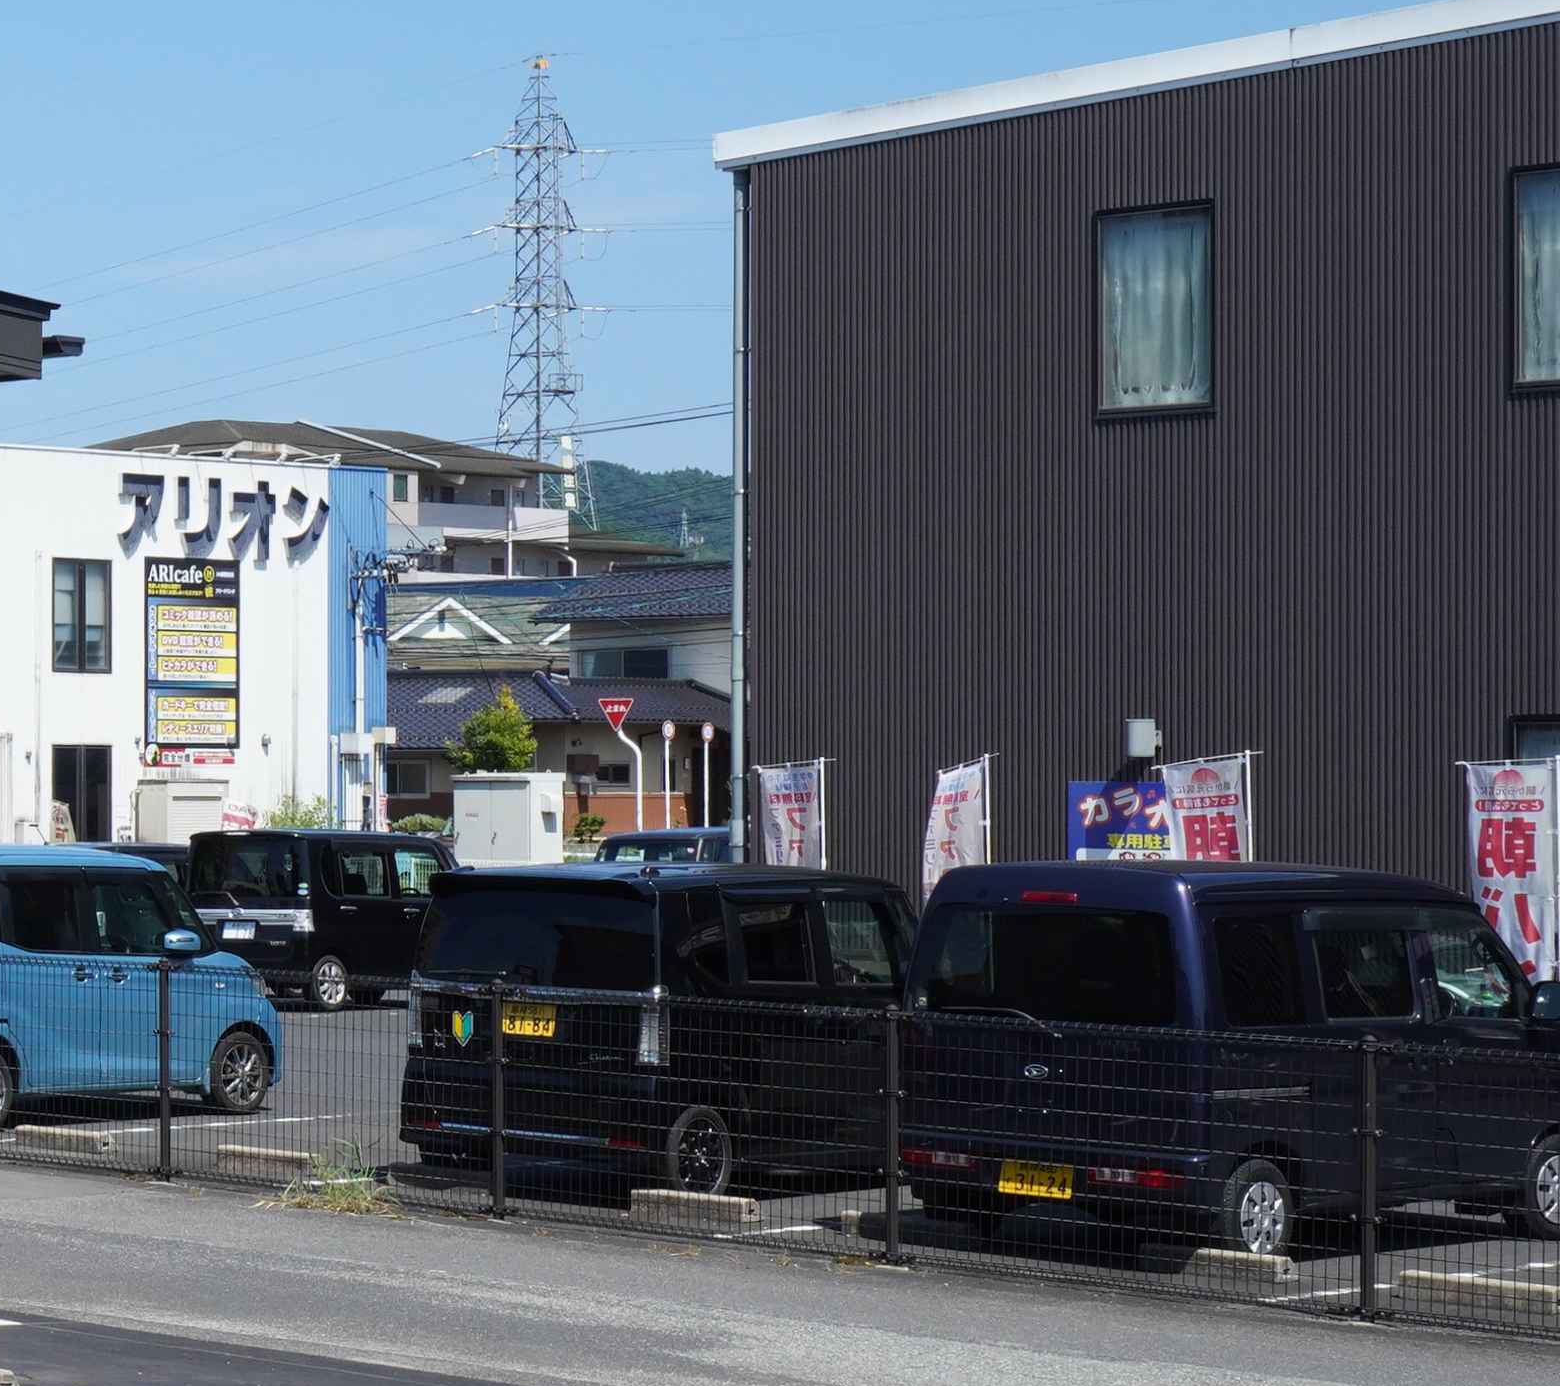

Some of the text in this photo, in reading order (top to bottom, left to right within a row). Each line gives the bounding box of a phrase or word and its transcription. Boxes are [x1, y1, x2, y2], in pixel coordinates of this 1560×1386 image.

[117, 472, 330, 564] アリオン
[147, 564, 203, 584] ARIcafe
[606, 705, 626, 713] 止まれ
[1015, 1173, 1068, 1197] 31-24
